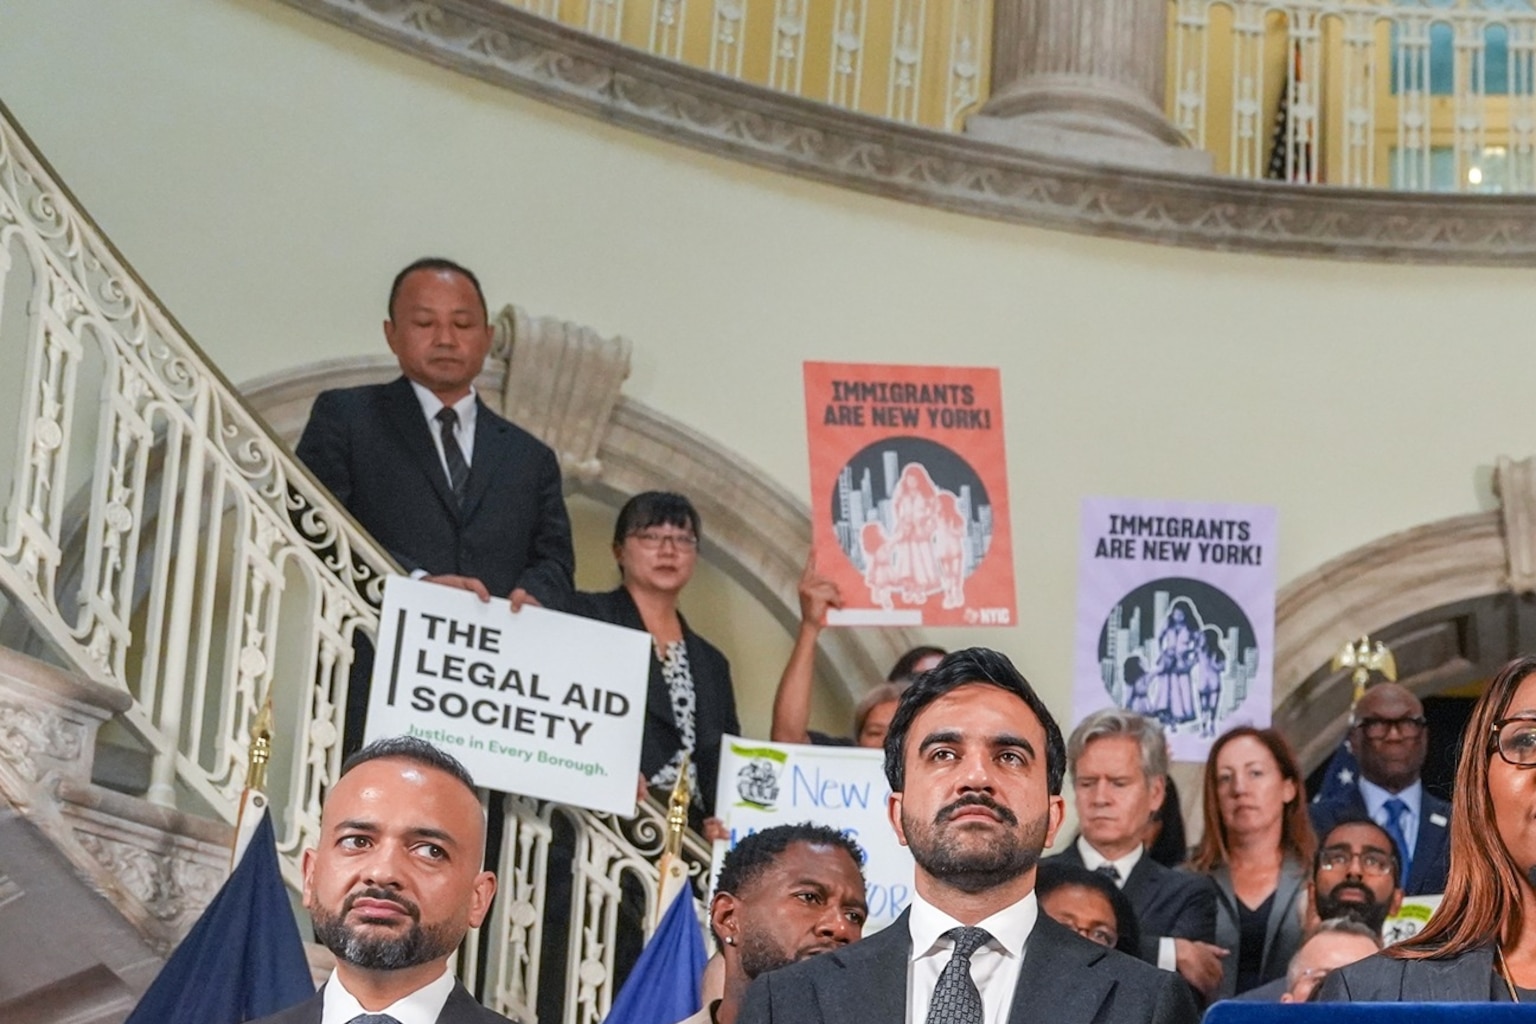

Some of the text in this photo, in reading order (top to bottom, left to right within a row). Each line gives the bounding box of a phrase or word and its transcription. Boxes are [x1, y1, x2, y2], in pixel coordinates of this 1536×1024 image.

[832, 380, 975, 406] IMMIGRANTS
[824, 404, 991, 430] ARE NEW YORK!
[1109, 514, 1250, 542] IMMIGRANTS
[1095, 537, 1262, 566] ARE NEW YORK!
[421, 613, 502, 654] THE
[416, 649, 631, 718] LEGAL AID
[410, 685, 593, 746] SOCIETY
[405, 723, 609, 777] Justice in Every Borough.
[791, 763, 871, 809] New
